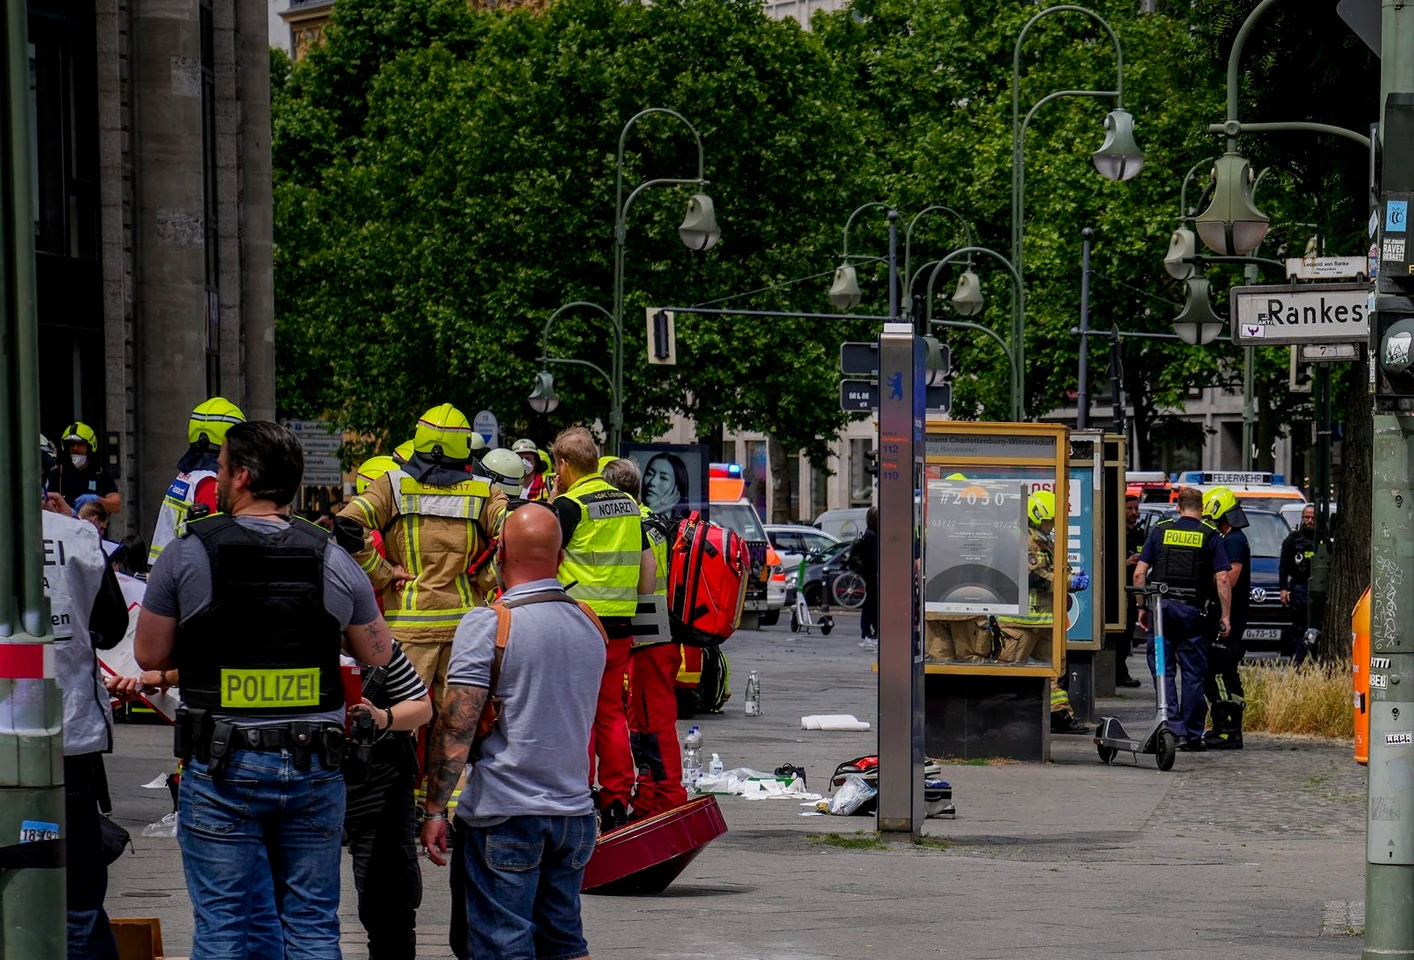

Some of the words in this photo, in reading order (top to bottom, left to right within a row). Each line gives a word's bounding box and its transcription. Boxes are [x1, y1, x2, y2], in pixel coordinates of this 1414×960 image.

[1383, 244, 1405, 253] RAVEN
[884, 444, 899, 453] 112
[1213, 474, 1262, 482] FEUERWEHR
[599, 501, 634, 516] NOTARZT
[1166, 531, 1202, 545] POLIZEI
[227, 674, 314, 701] POLIZEI
